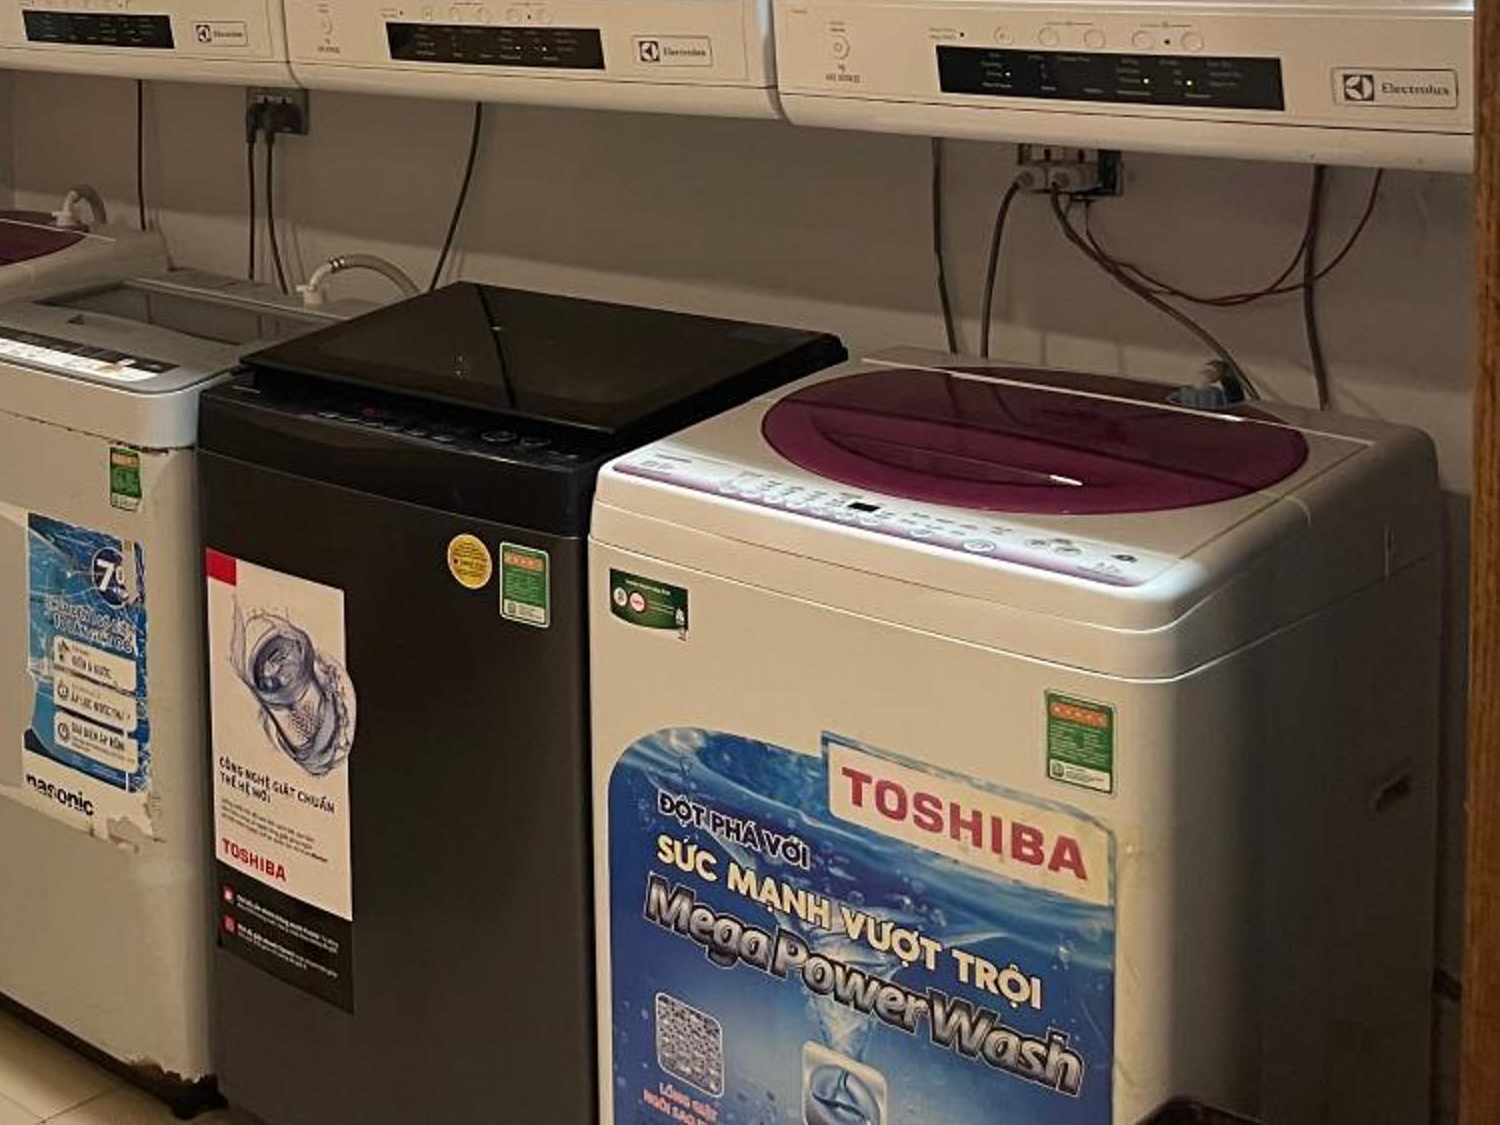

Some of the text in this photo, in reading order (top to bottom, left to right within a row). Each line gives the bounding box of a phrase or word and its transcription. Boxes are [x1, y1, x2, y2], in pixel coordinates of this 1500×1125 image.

[1381, 81, 1450, 96] Electrolux
[658, 789, 707, 828] ĐỘT
[709, 809, 763, 853] PHÁ
[841, 765, 1089, 882] TOSHIBA
[221, 836, 287, 883] TOSHIBA
[657, 833, 1043, 1011] SỨC MẠNH VƯỢT TRỘI
